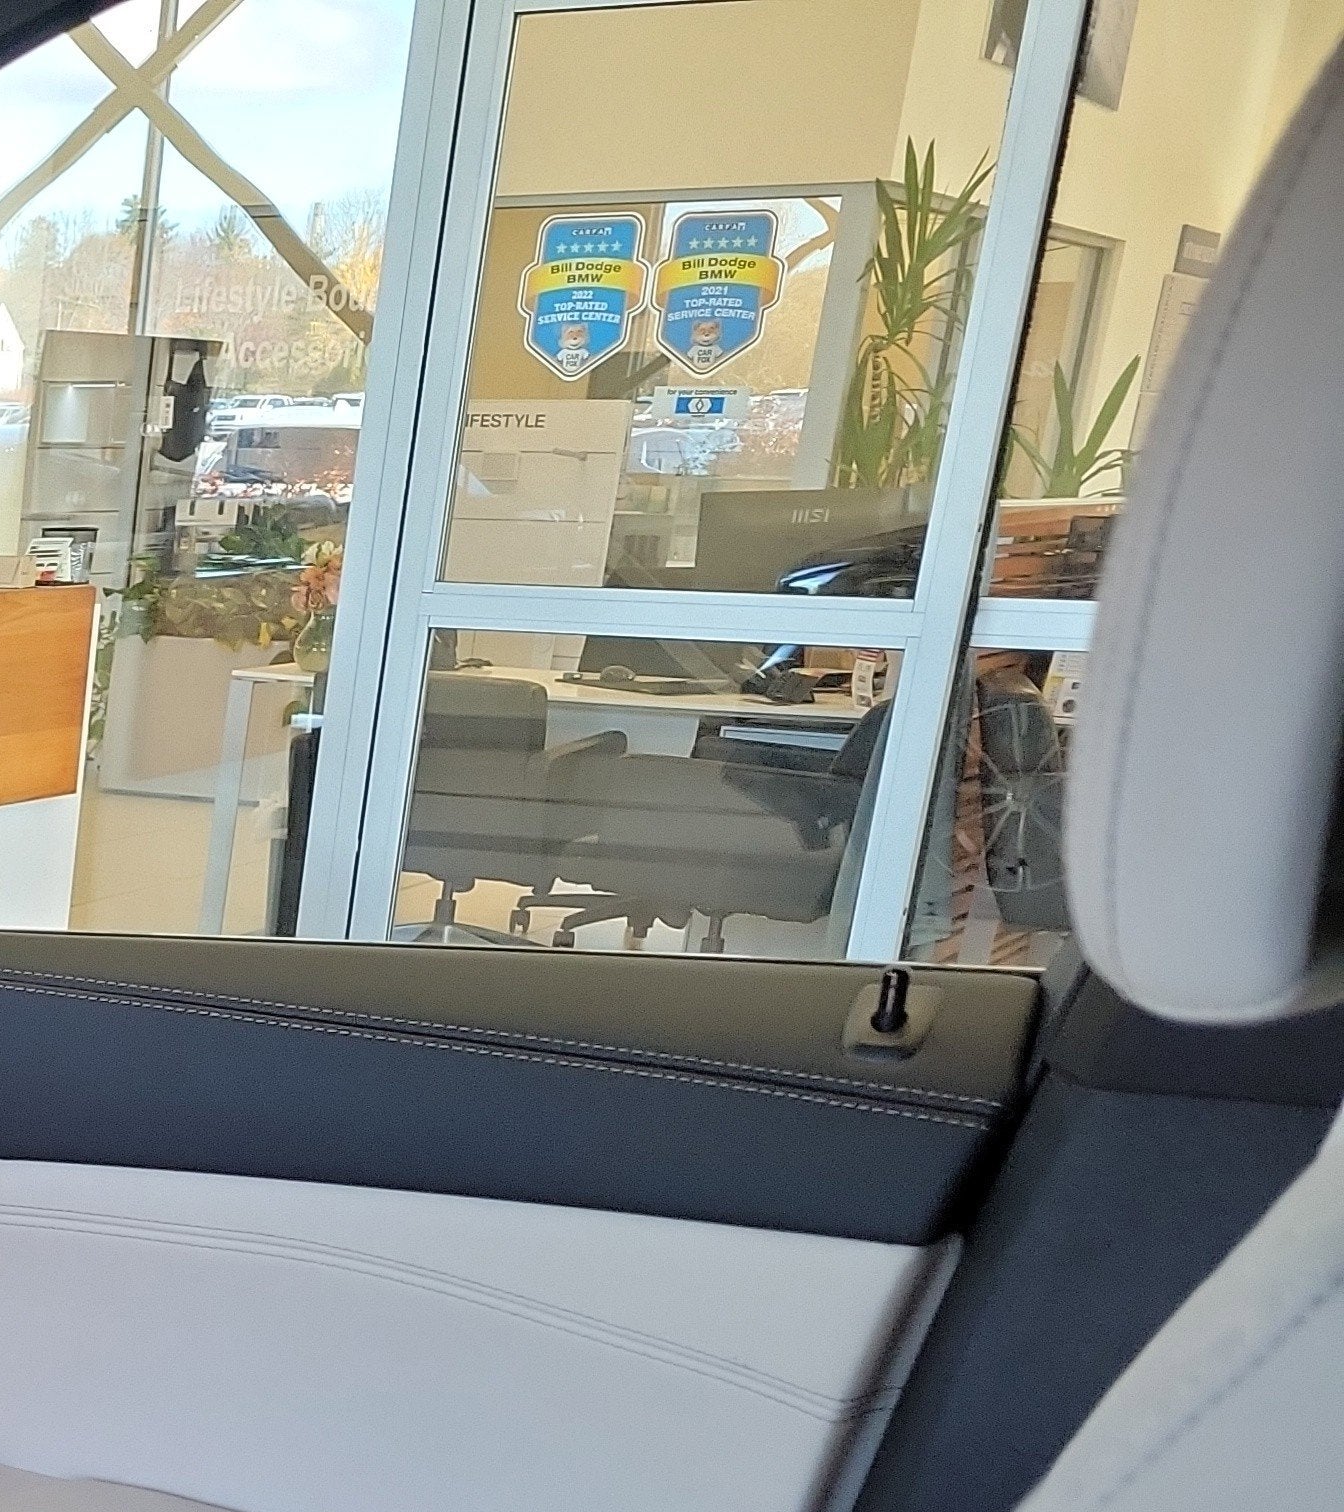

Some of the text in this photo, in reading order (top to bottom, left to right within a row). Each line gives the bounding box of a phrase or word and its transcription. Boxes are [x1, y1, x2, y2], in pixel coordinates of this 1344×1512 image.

[550, 261, 622, 275] Bill Dodge
[682, 257, 756, 271] Bill Dodge
[566, 274, 603, 284] BMW
[699, 269, 737, 280] BMW
[572, 290, 594, 300] 2022
[701, 286, 728, 296] 2021
[175, 276, 297, 322] Lifestyle
[683, 298, 743, 308] TOP-RATED
[553, 302, 608, 312] TOP-RATED
[537, 311, 621, 325] SERVICE CENTER
[667, 307, 756, 322] SERVICE CENTER
[565, 353, 580, 361] CAR
[697, 349, 713, 357] CAR
[667, 388, 738, 397] for your convenience
